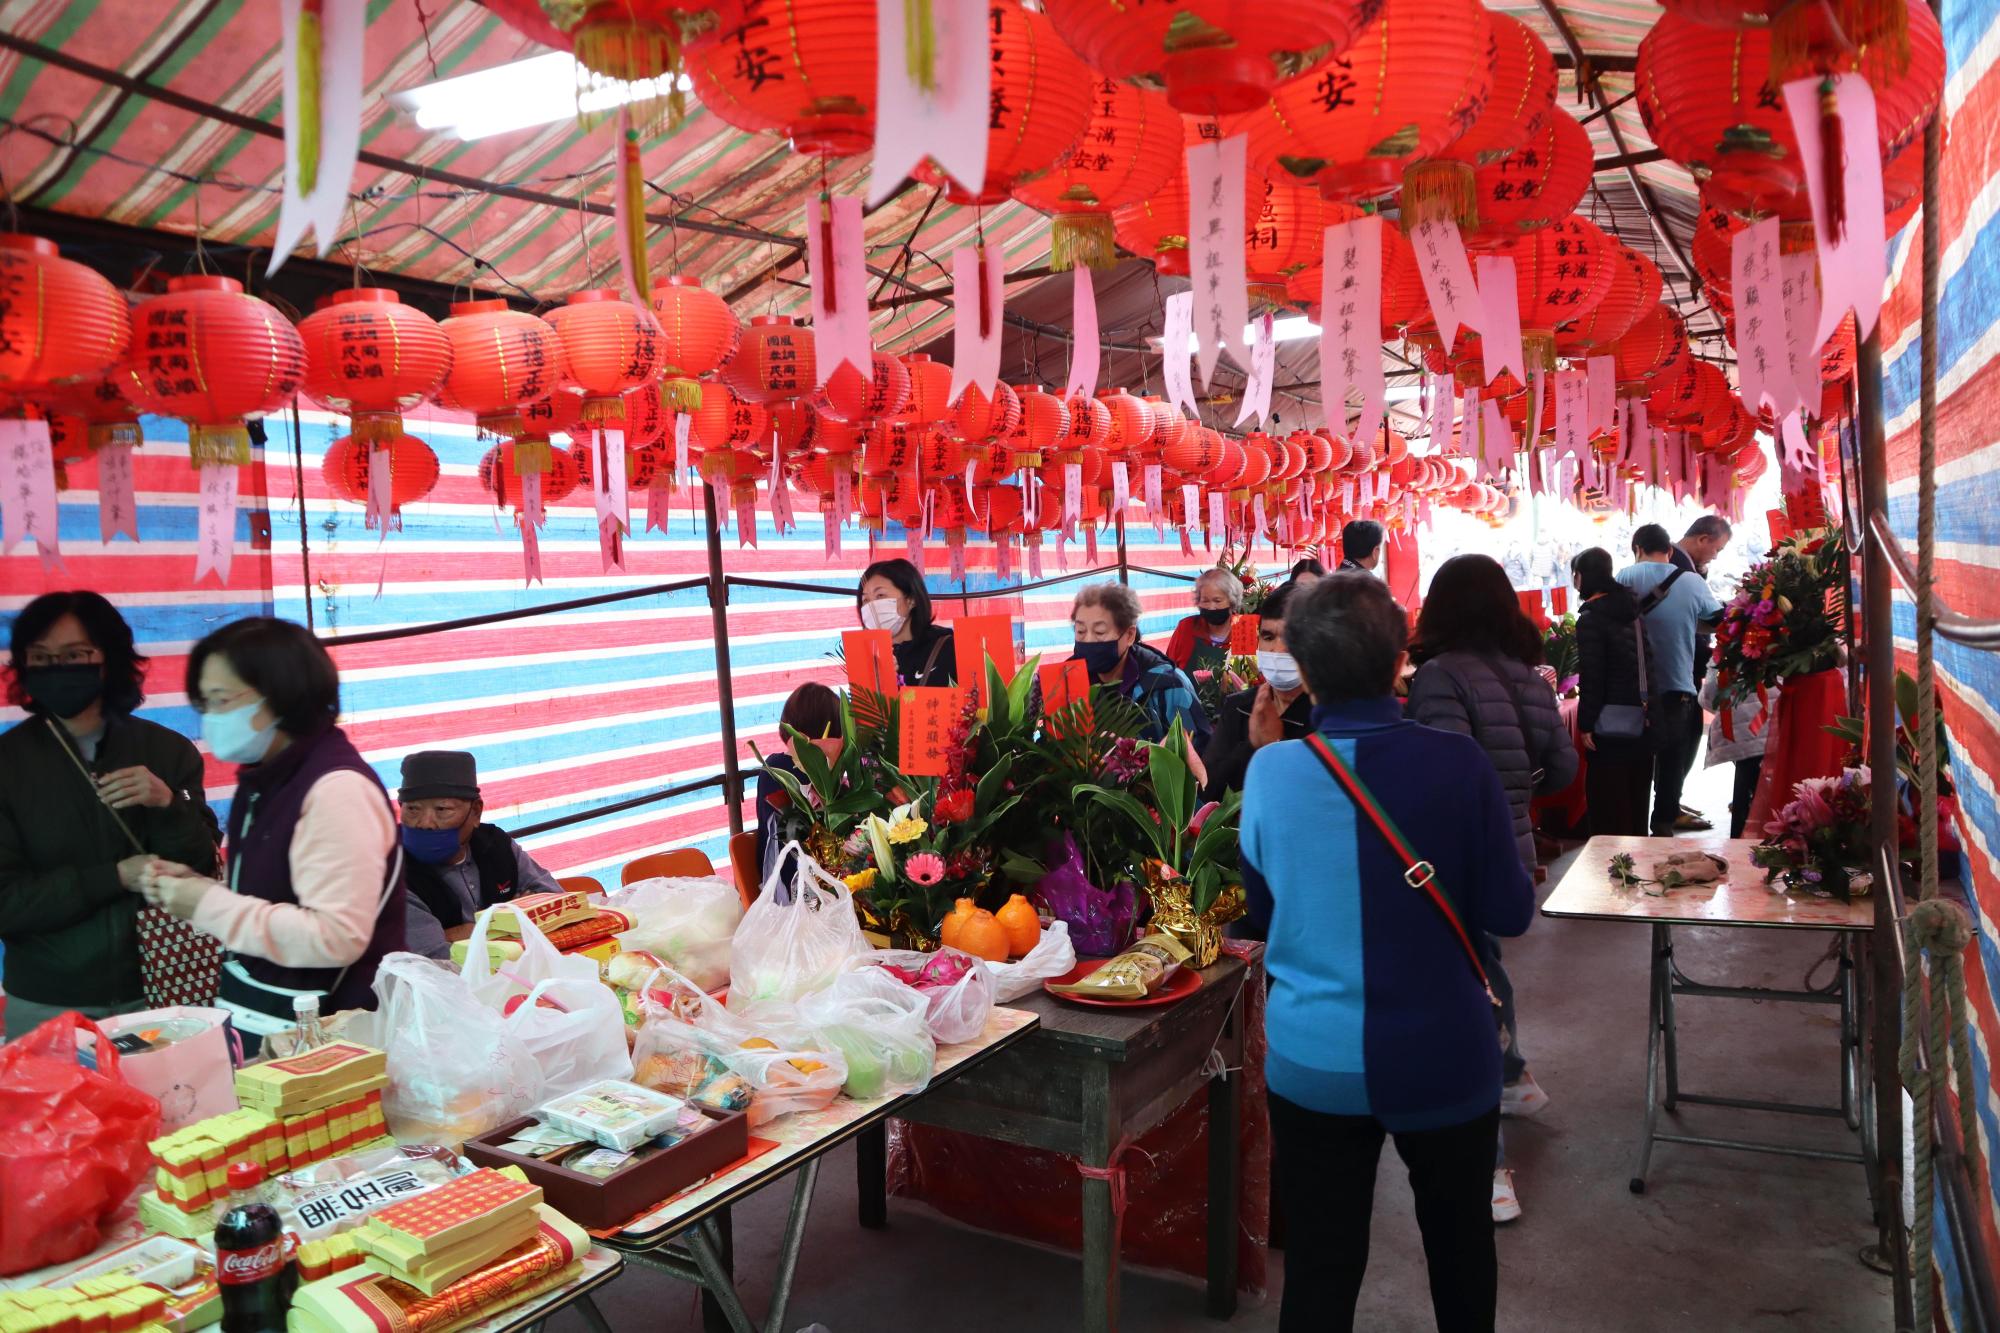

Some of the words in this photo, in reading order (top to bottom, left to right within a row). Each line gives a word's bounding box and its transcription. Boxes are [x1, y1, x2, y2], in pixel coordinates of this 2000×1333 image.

[1097, 77, 1119, 171] 金玉滿堂
[1546, 219, 1571, 305] 合家平安
[1566, 220, 1589, 304] 金玉滿堂
[147, 309, 175, 397] 國泰民安
[163, 309, 199, 395] 風調雨順
[339, 314, 362, 380] 國泰民安
[357, 313, 385, 379] 風調雨順
[767, 335, 784, 391] 國泰民安
[782, 335, 798, 390] 風調雨順
[1074, 399, 1092, 438] 福德祠
